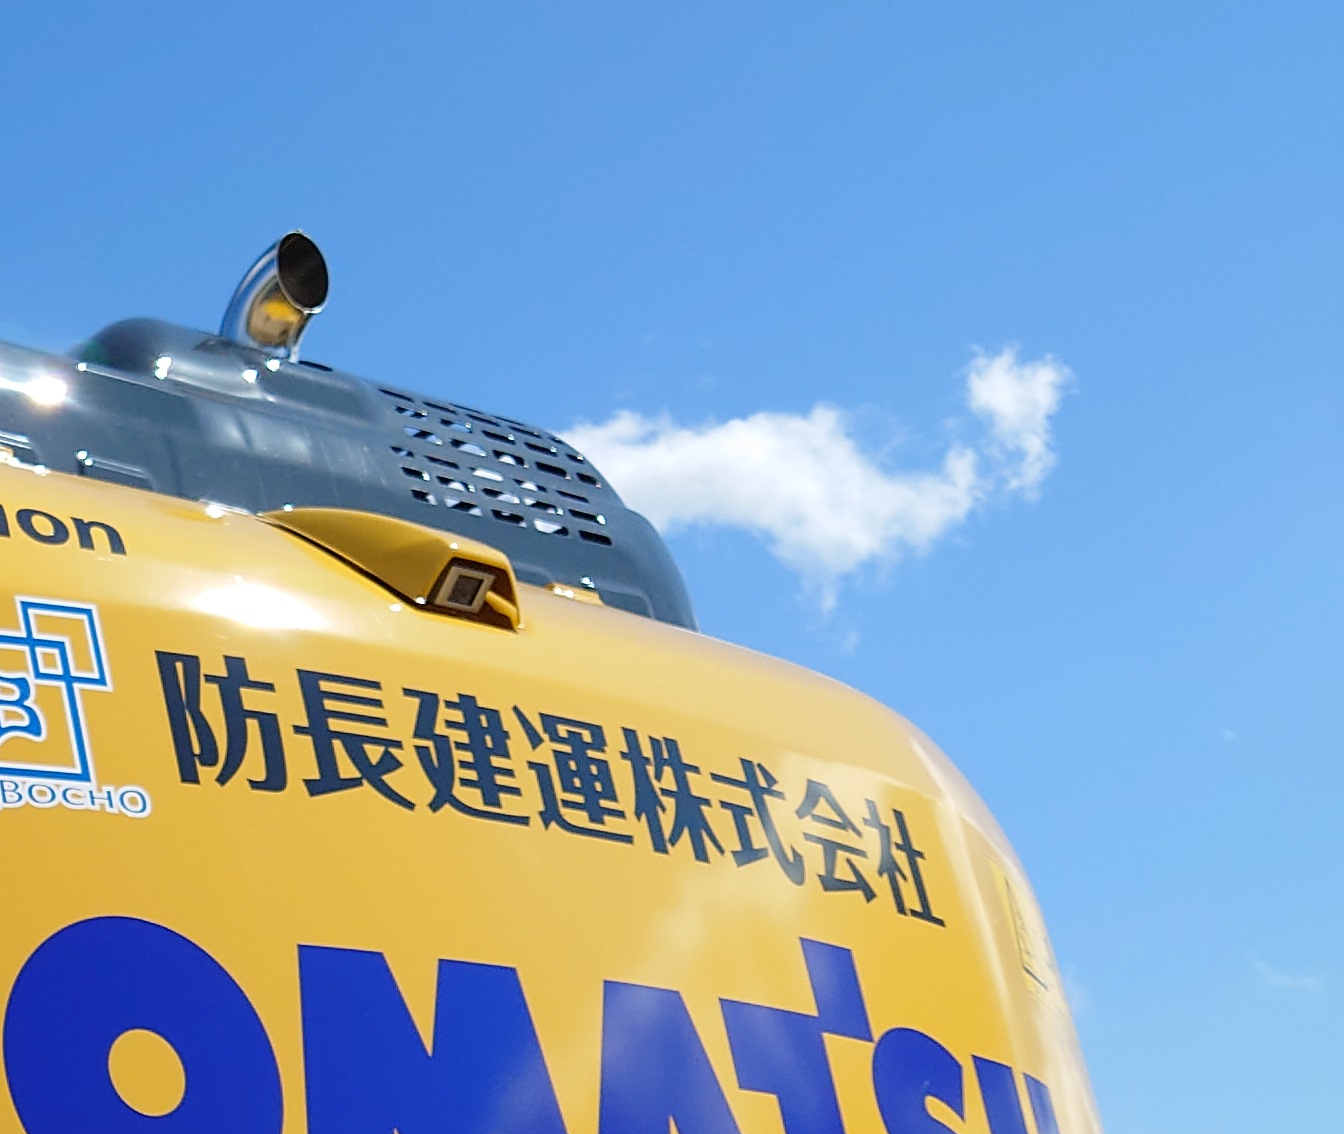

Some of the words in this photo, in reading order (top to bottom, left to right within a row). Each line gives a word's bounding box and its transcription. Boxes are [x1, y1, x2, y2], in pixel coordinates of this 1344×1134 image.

[0, 780, 148, 814] BOCHO
[154, 649, 946, 928] 防長建運株式会社
